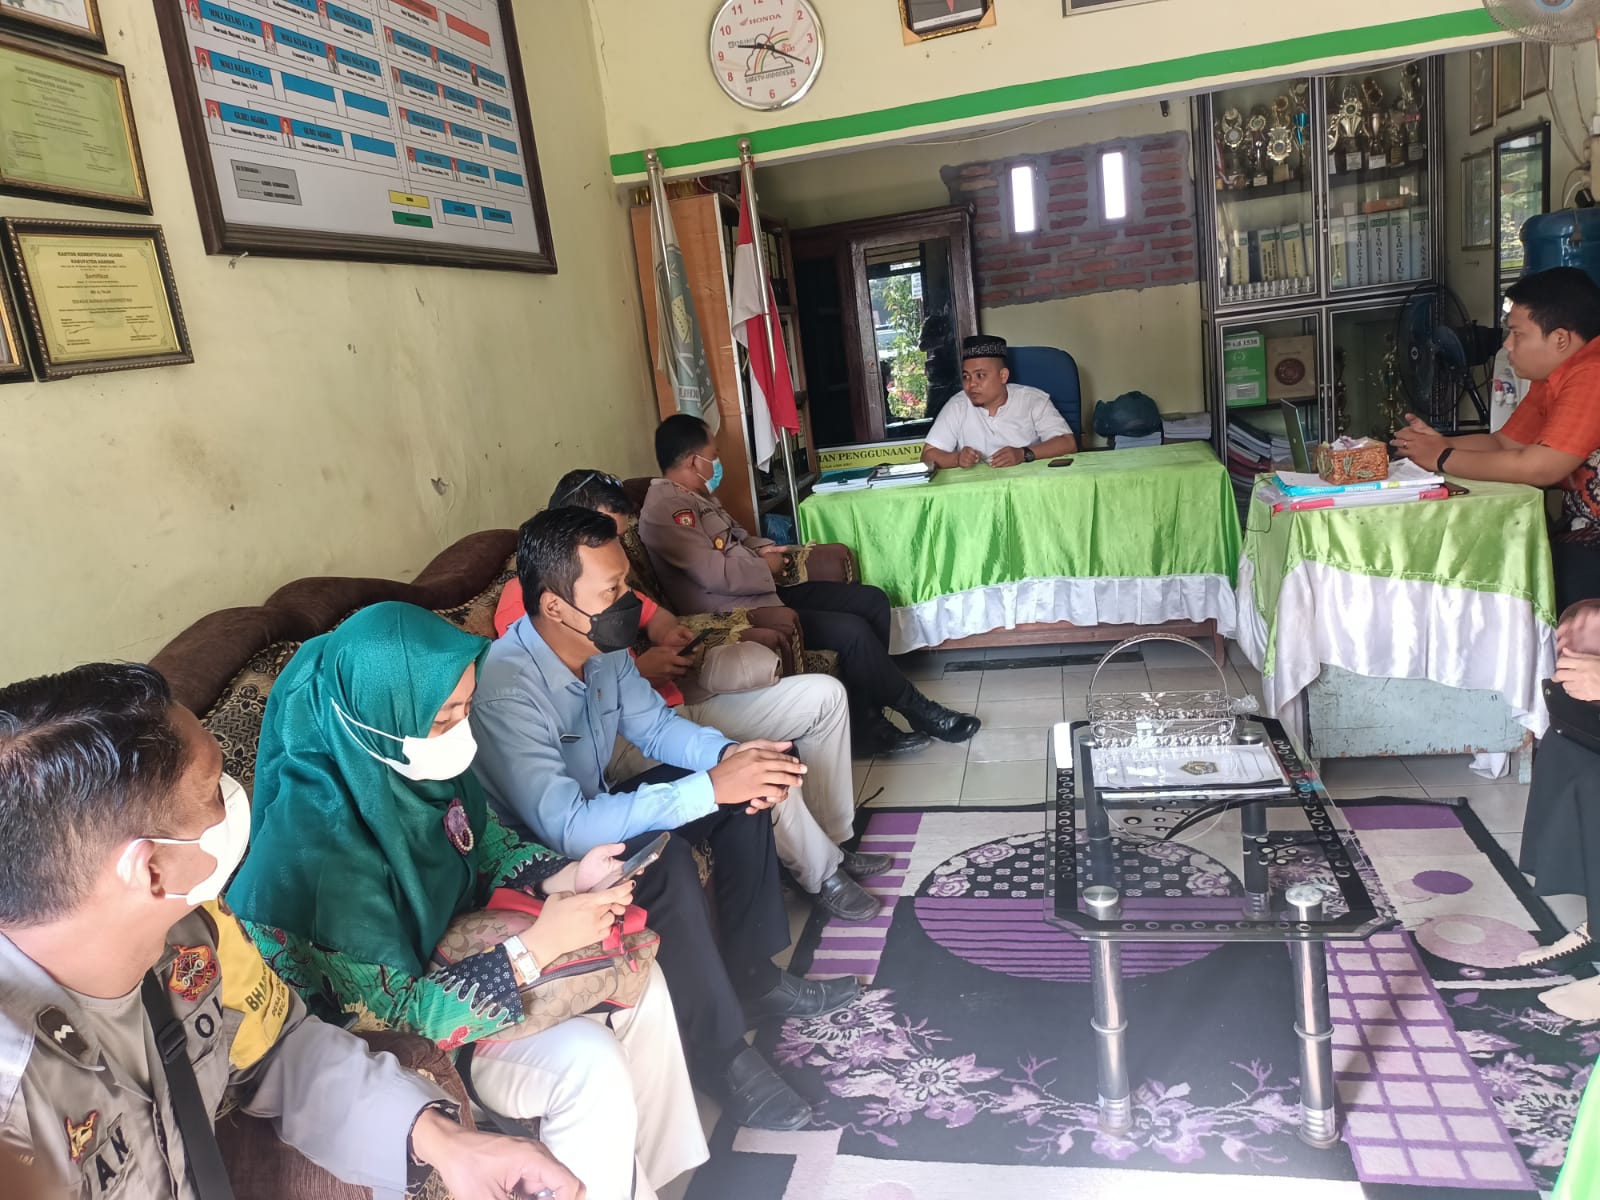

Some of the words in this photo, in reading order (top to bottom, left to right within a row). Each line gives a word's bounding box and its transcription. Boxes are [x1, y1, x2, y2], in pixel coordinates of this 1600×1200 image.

[732, 4, 743, 15] 11
[750, 13, 782, 24] HONDA
[797, 10, 804, 20] 2
[720, 25, 731, 36] 10
[807, 33, 813, 43] 3
[718, 51, 724, 61] 9
[805, 56, 811, 66] 4
[728, 72, 734, 82] 8
[790, 78, 797, 88] 5
[747, 87, 753, 97] 7
[769, 89, 776, 99] 6
[838, 446, 911, 461] PENGGUNAAN
